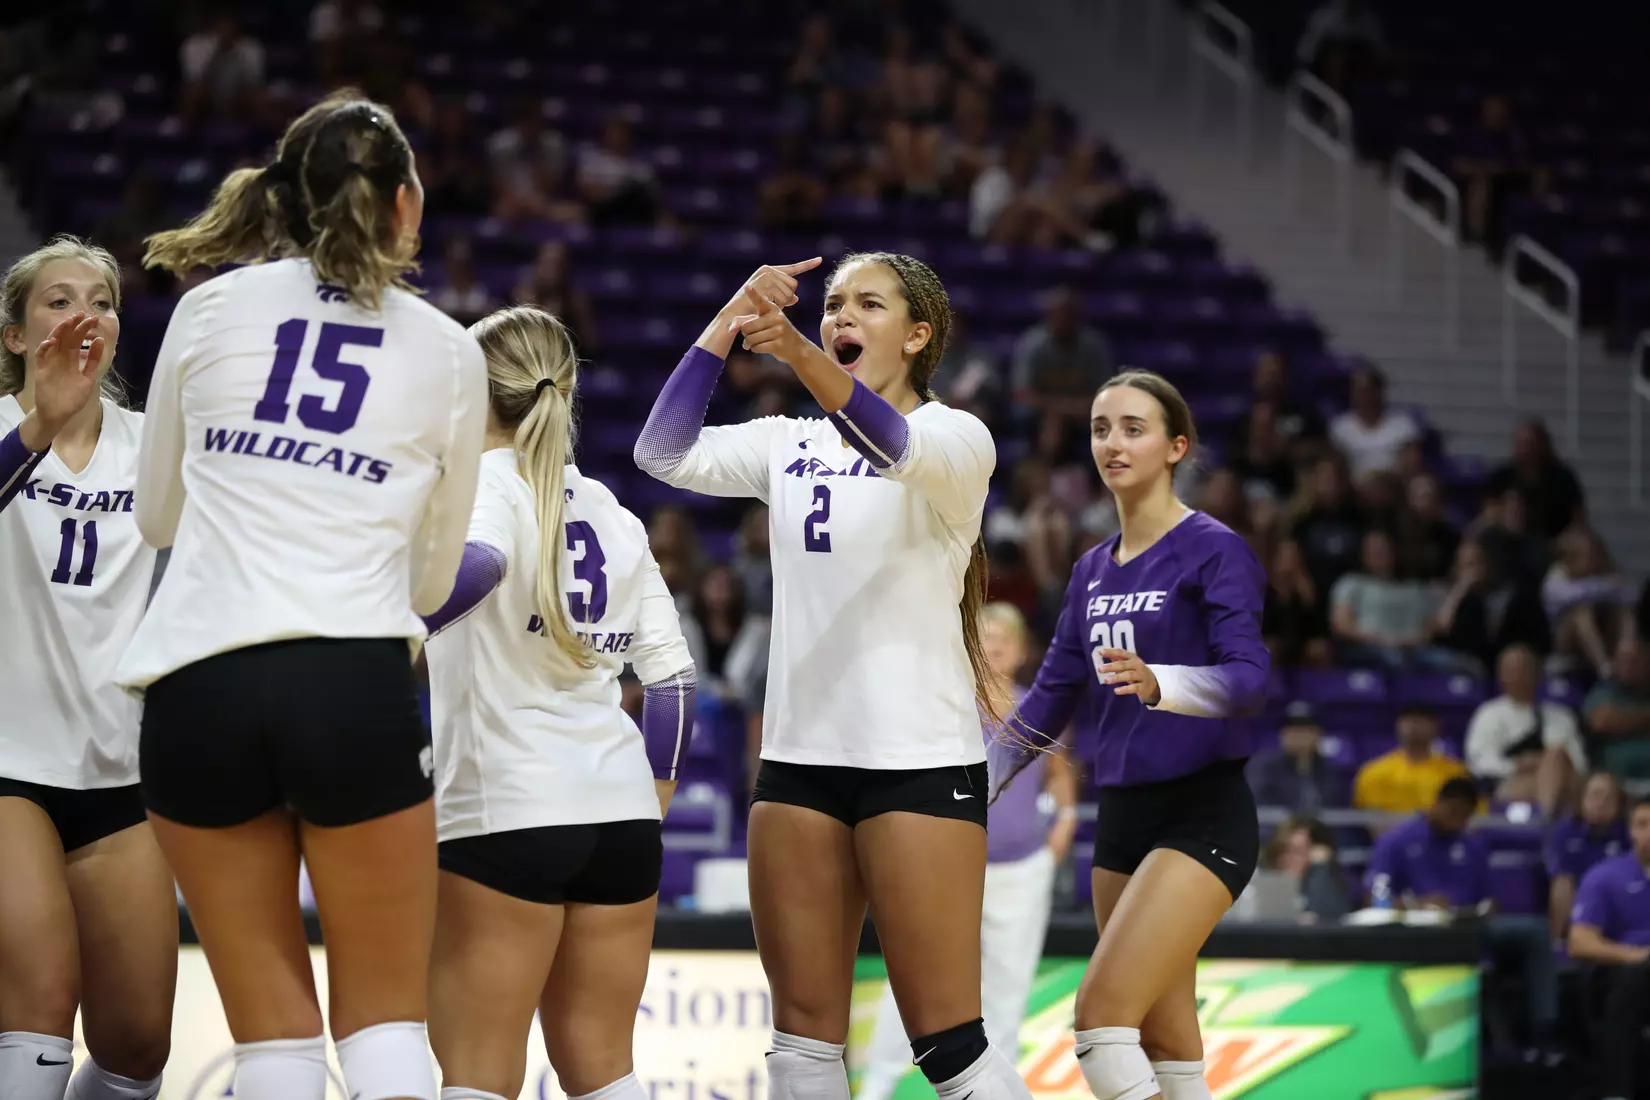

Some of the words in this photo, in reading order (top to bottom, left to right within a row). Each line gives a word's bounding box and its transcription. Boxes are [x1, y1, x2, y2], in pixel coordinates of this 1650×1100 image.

[253, 317, 385, 435] 15
[203, 427, 393, 485] WILDCATS
[50, 517, 98, 587] 11
[804, 484, 832, 553] 2
[565, 520, 608, 625] 3
